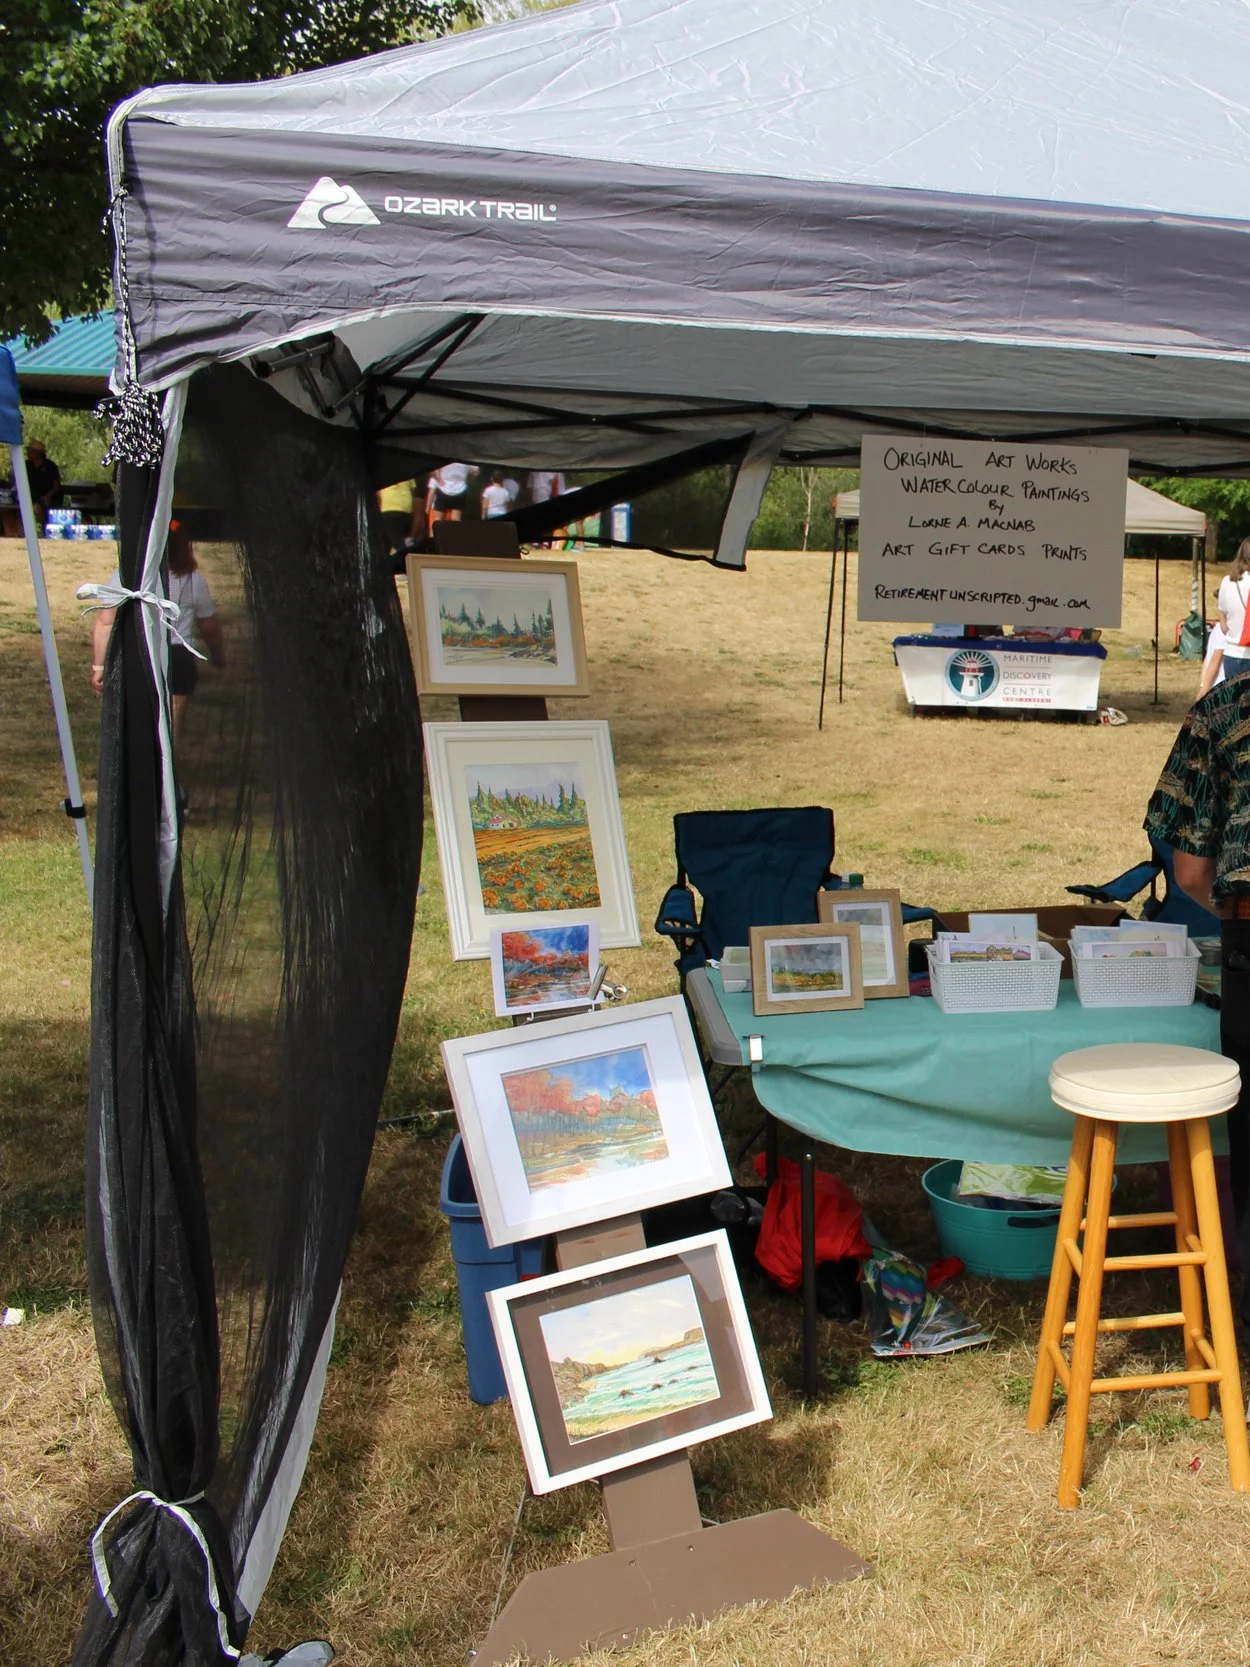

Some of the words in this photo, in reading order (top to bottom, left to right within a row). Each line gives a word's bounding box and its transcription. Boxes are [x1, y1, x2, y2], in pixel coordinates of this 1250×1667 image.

[384, 195, 476, 217] OZARK
[883, 447, 963, 471] ORIGINAL
[985, 451, 1016, 469] ART
[1026, 452, 1078, 475] WORKS
[1021, 480, 1090, 503] PAINTINGS
[908, 516, 951, 529] LORNE
[977, 517, 1036, 532] MACNAB
[881, 543, 915, 557] ART
[928, 542, 971, 556] GIFT
[977, 543, 1026, 557] CARDS
[1041, 543, 1088, 561] PRINTS
[1003, 654, 1053, 664] MARITIME
[1003, 671, 1052, 681] DISCOVERY
[1003, 687, 1051, 697] CENTRE
